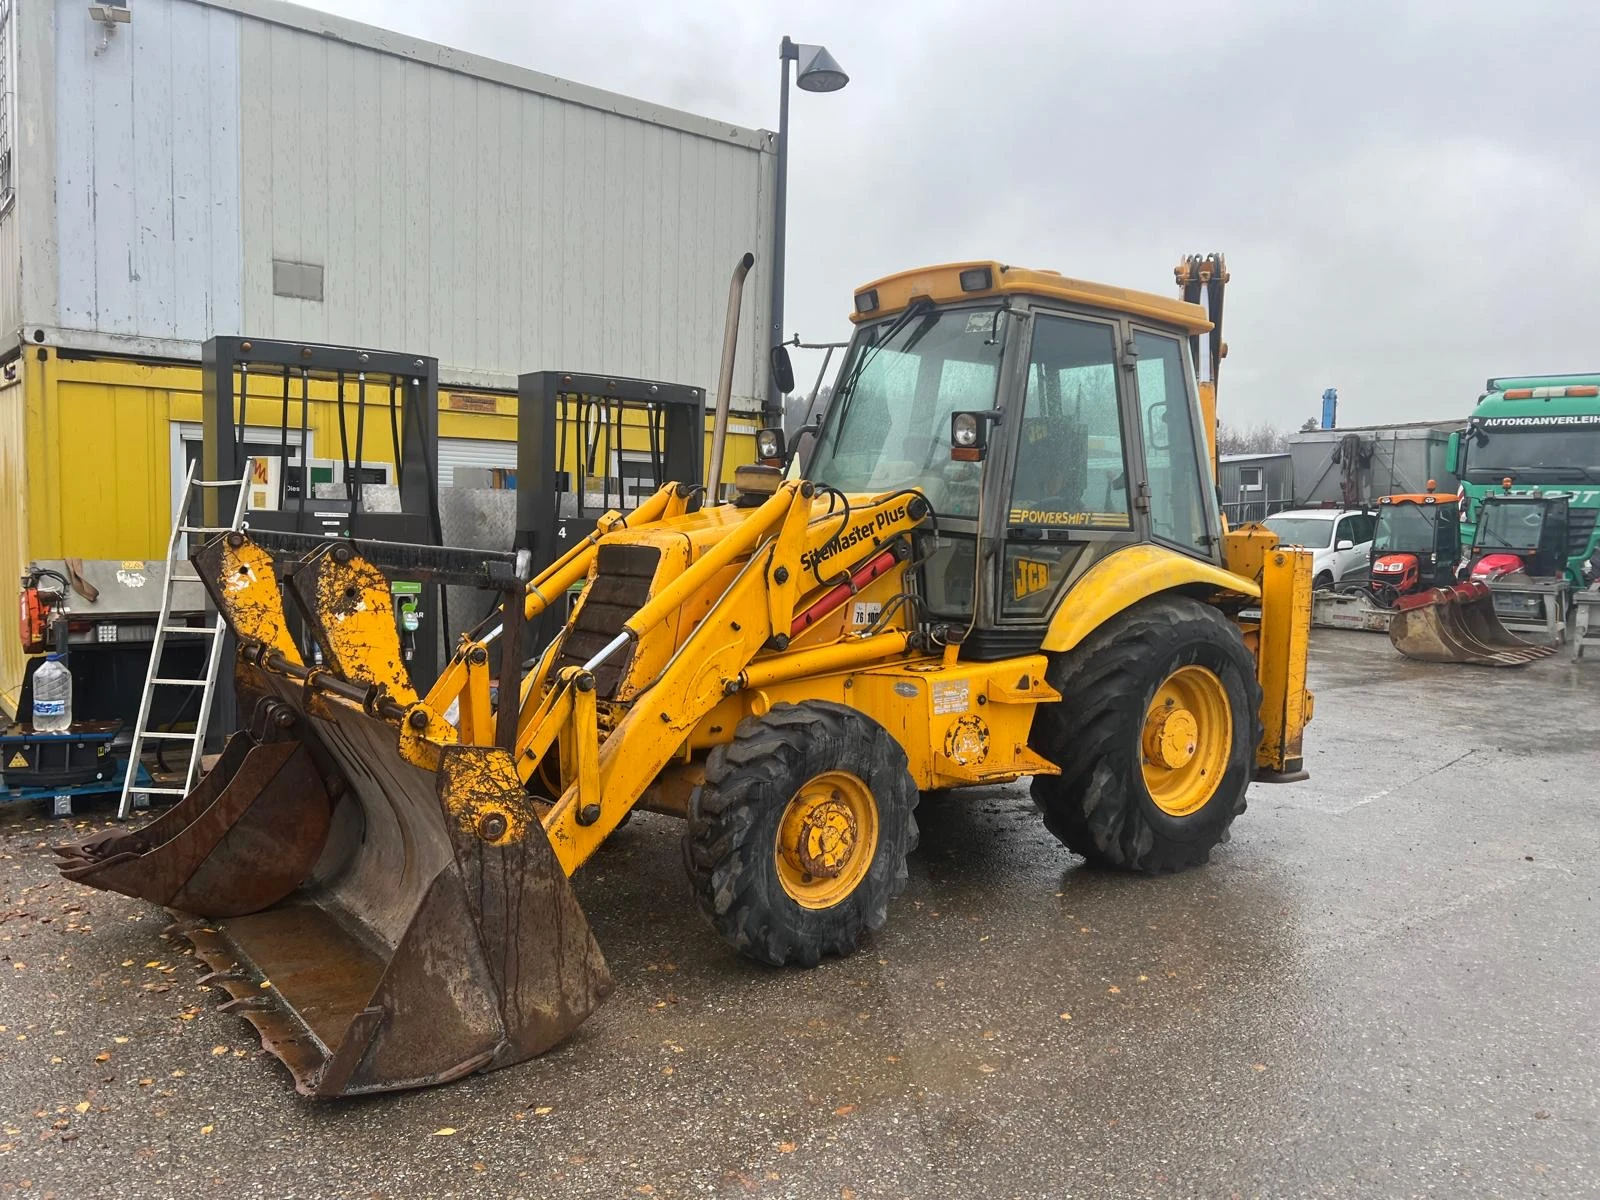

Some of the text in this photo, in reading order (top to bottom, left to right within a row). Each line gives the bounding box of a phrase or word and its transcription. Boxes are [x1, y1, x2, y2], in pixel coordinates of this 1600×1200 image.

[1484, 415, 1600, 427] AUTOKRANVERLEIH
[1020, 510, 1092, 525] POWERSHIFT
[558, 526, 567, 539] 4
[800, 505, 906, 572] SiteMaster Plus
[1016, 559, 1048, 599] JCB
[856, 612, 864, 624] 76
